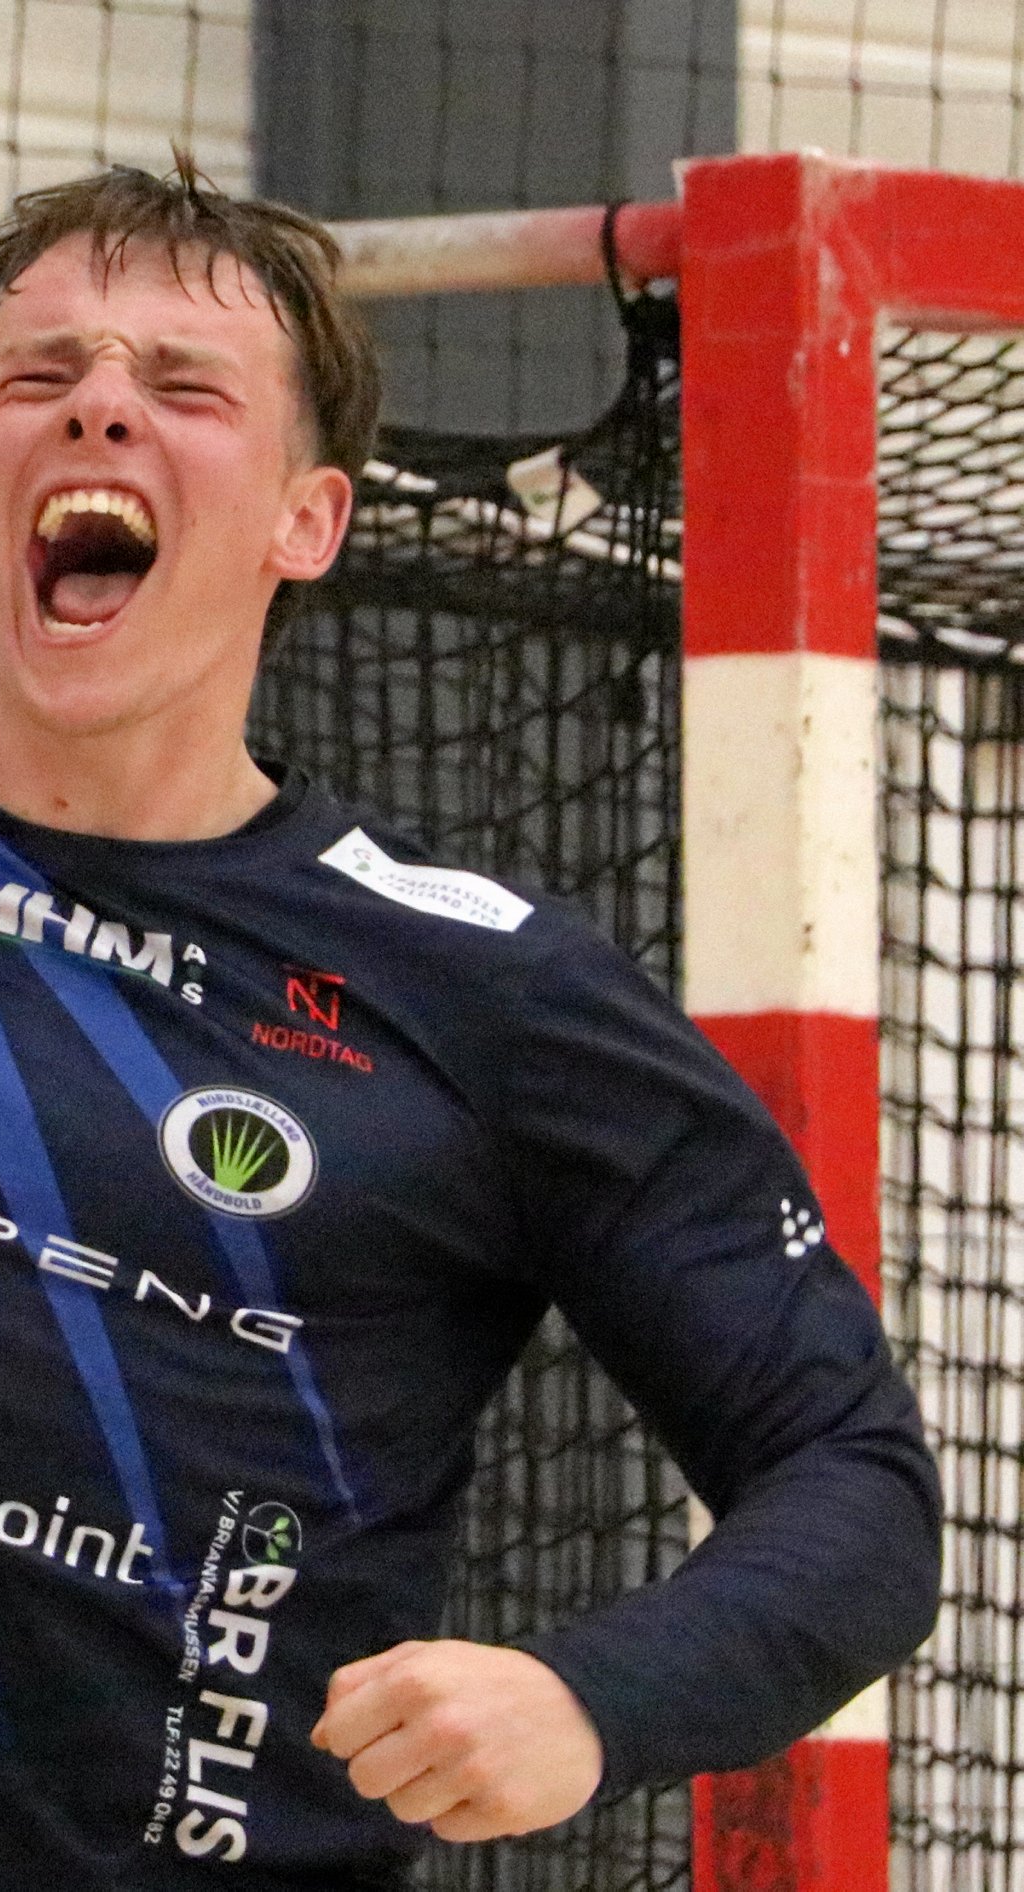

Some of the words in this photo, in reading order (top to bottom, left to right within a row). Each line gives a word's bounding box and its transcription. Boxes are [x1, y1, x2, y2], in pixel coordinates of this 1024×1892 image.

[251, 1023, 374, 1073] NORDTAG
[196, 1093, 302, 1143] NORDSJÆLLAND
[186, 1171, 263, 1210] HÅNDBOLD
[178, 1576, 218, 1683] ASMUSSEN
[207, 1563, 298, 1675] BR
[164, 1745, 181, 1771] 22
[176, 1689, 269, 1864] FLIS
[159, 1773, 178, 1799] 49
